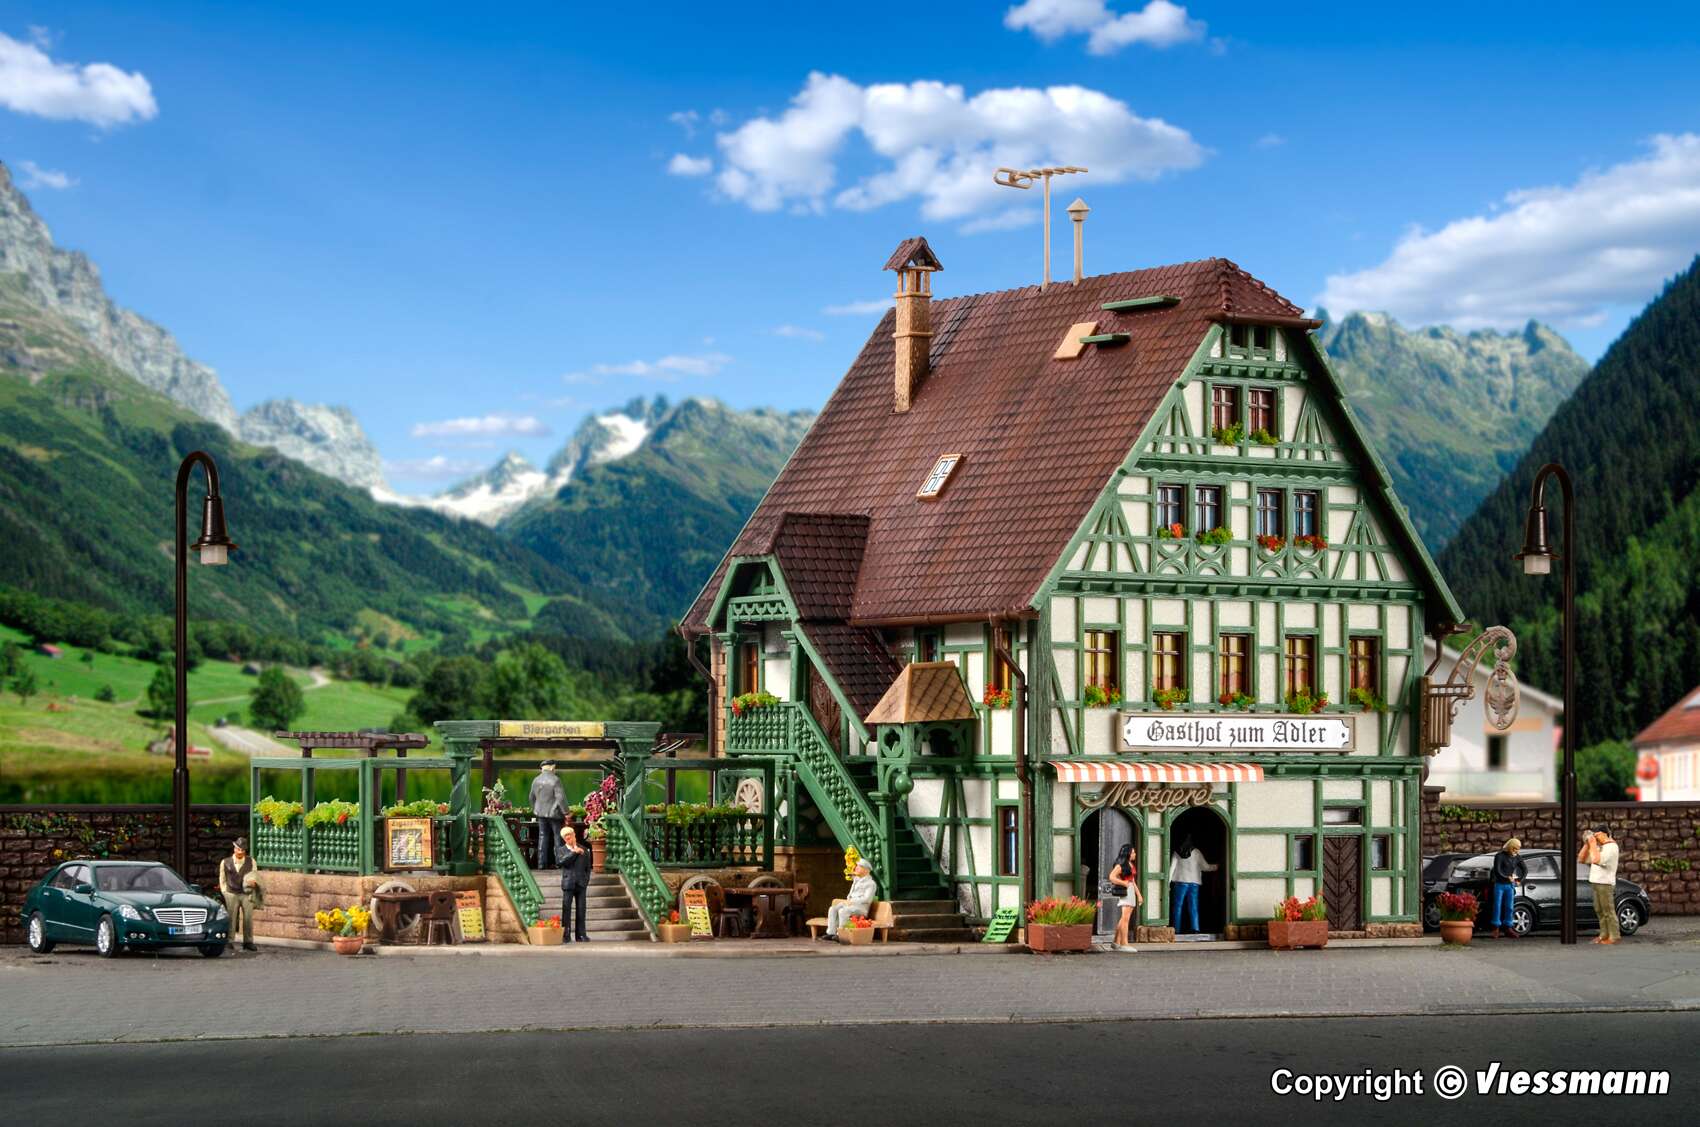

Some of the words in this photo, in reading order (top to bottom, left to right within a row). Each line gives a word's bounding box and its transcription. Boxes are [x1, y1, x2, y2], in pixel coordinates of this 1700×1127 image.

[522, 723, 581, 736] Biergarten
[1147, 720, 1223, 747] Gasthof
[1229, 726, 1264, 747] zum
[1273, 720, 1327, 744] Adler
[1077, 781, 1219, 813] Metzgerei
